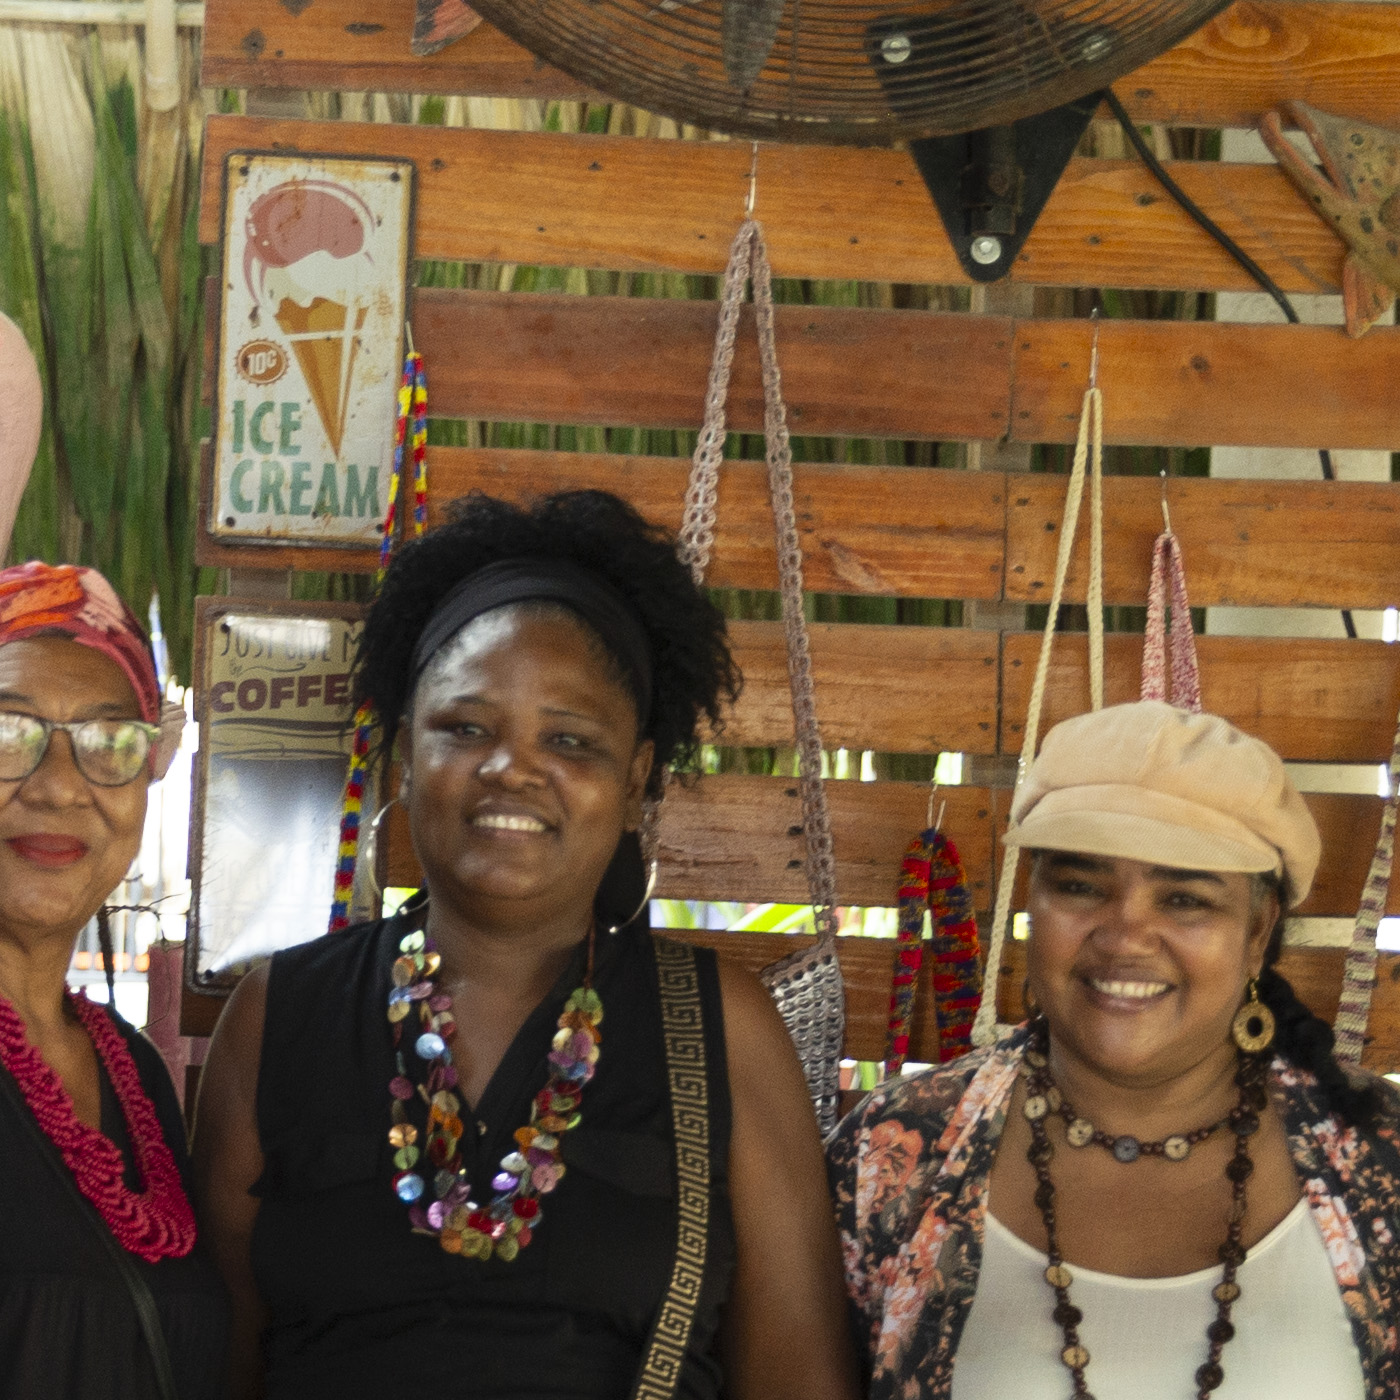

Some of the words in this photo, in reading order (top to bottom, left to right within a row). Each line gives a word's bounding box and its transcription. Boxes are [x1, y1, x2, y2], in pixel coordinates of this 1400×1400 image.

[232, 399, 302, 456] ICE
[229, 459, 381, 519] CREAM
[211, 674, 356, 713] COFFE
